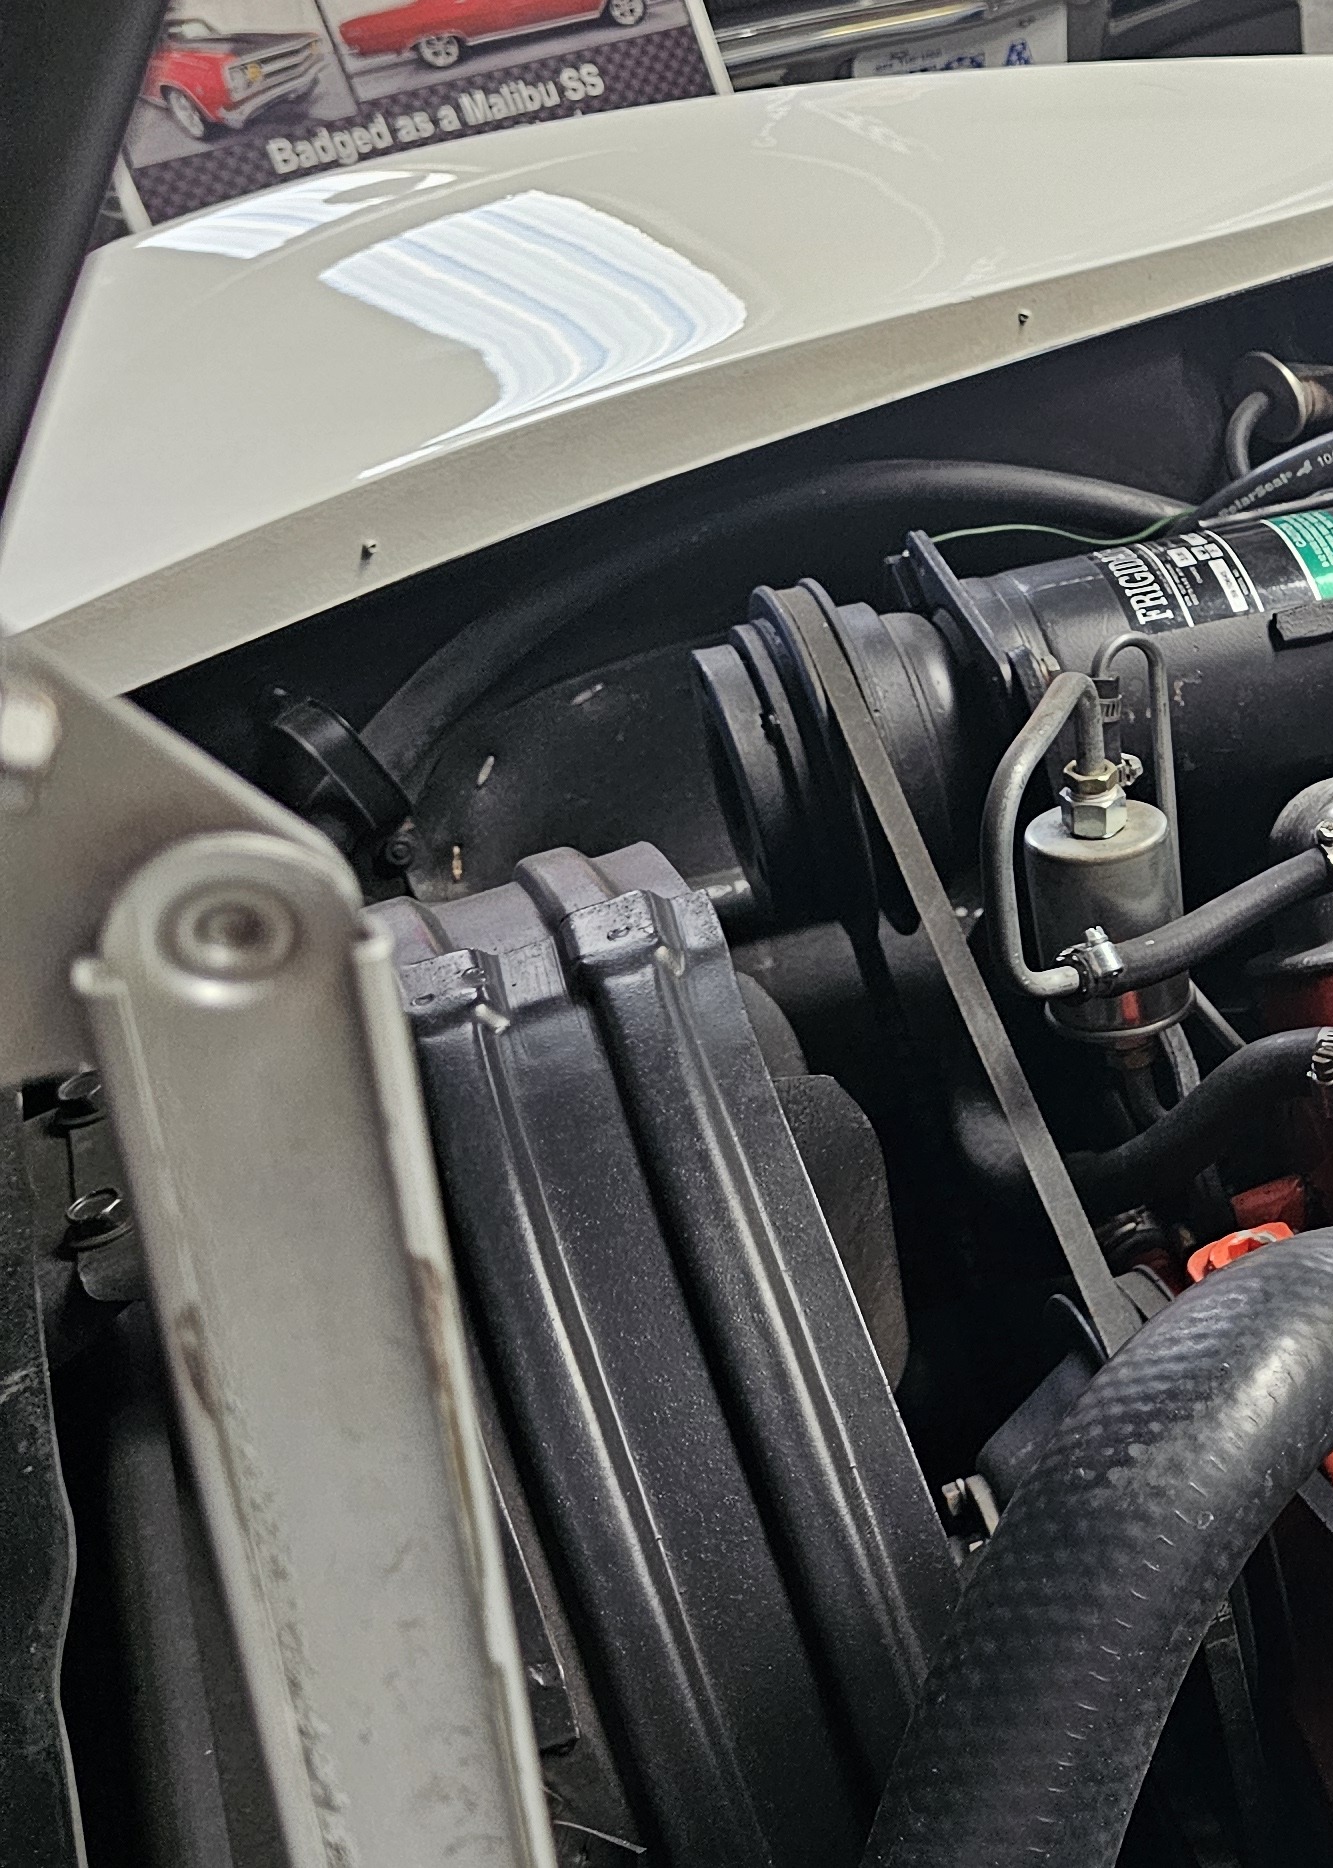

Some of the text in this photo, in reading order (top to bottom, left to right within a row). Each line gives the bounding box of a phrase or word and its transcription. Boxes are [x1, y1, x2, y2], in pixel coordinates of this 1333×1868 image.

[266, 112, 394, 174] Badged
[395, 110, 435, 142] as
[436, 104, 463, 133] a
[457, 79, 561, 126] Malibu
[559, 62, 605, 101] SS
[1097, 546, 1175, 625] FRIGID
